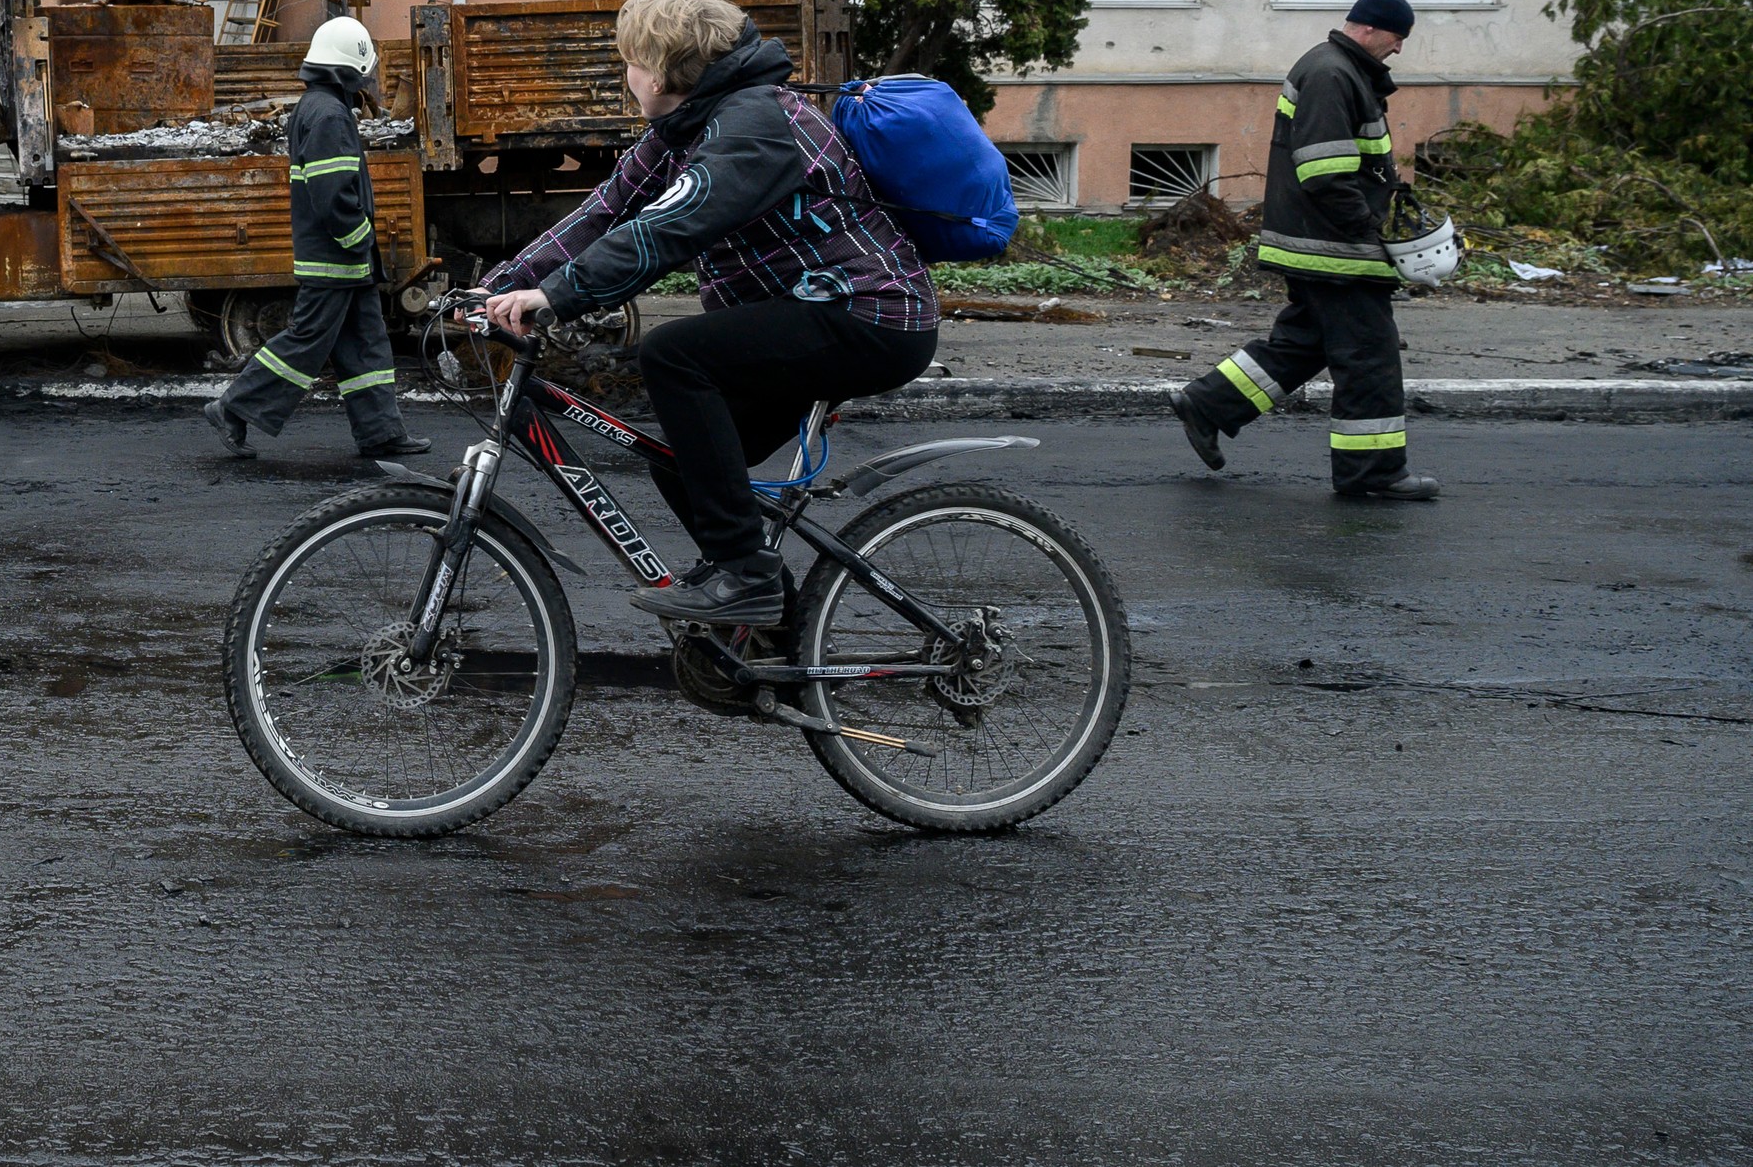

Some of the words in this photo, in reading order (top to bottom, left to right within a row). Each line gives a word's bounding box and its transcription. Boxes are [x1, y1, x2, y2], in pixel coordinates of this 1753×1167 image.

[563, 404, 638, 447] ROCKS
[554, 464, 670, 581] ARDIS
[824, 666, 843, 675] THE
[843, 666, 871, 675] ROAD
